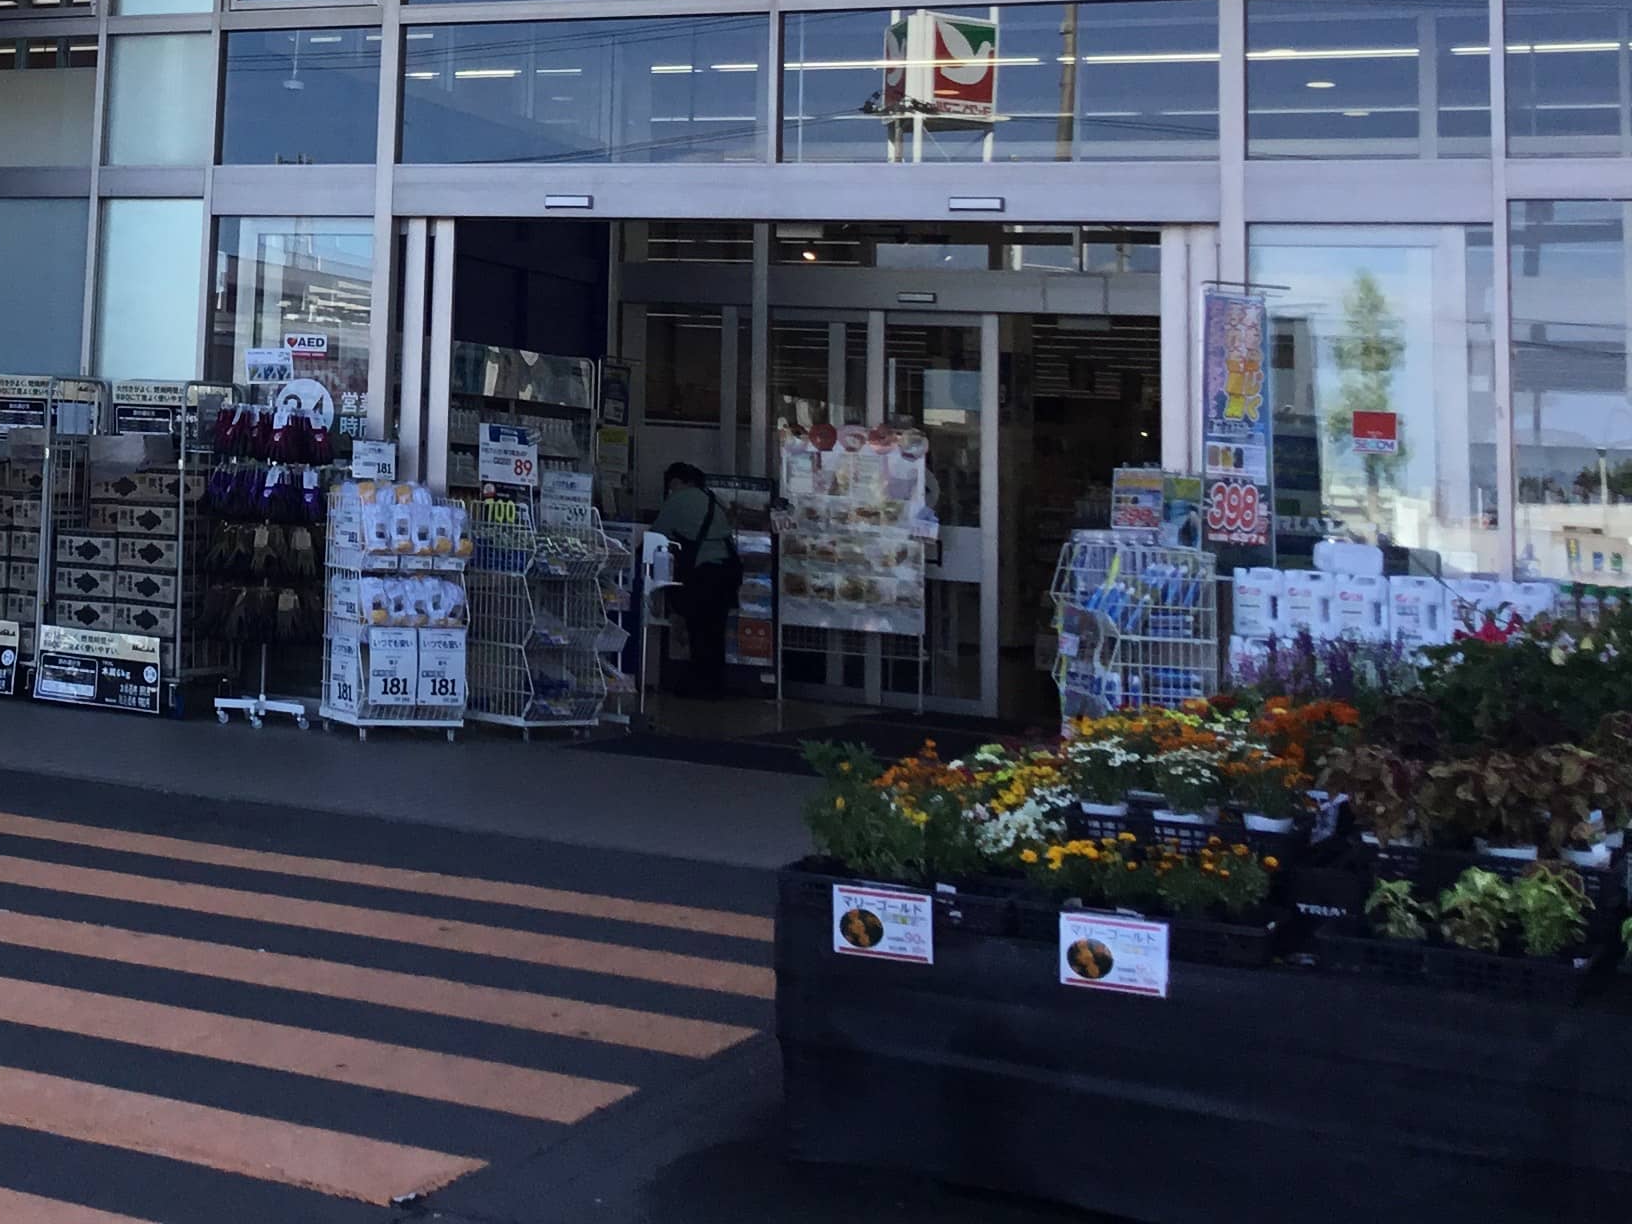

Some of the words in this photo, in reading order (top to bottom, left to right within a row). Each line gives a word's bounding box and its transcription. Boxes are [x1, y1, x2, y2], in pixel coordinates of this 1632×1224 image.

[298, 337, 325, 348] AED
[1354, 439, 1395, 450] SECOM
[376, 462, 393, 475] 181
[513, 458, 533, 477] 89
[1207, 481, 1260, 532] 398
[337, 681, 353, 702] 181
[381, 677, 409, 696] 181
[430, 678, 458, 697] 181
[842, 895, 923, 914] マリーゴールド
[1070, 923, 1156, 945] マリーゴールド
